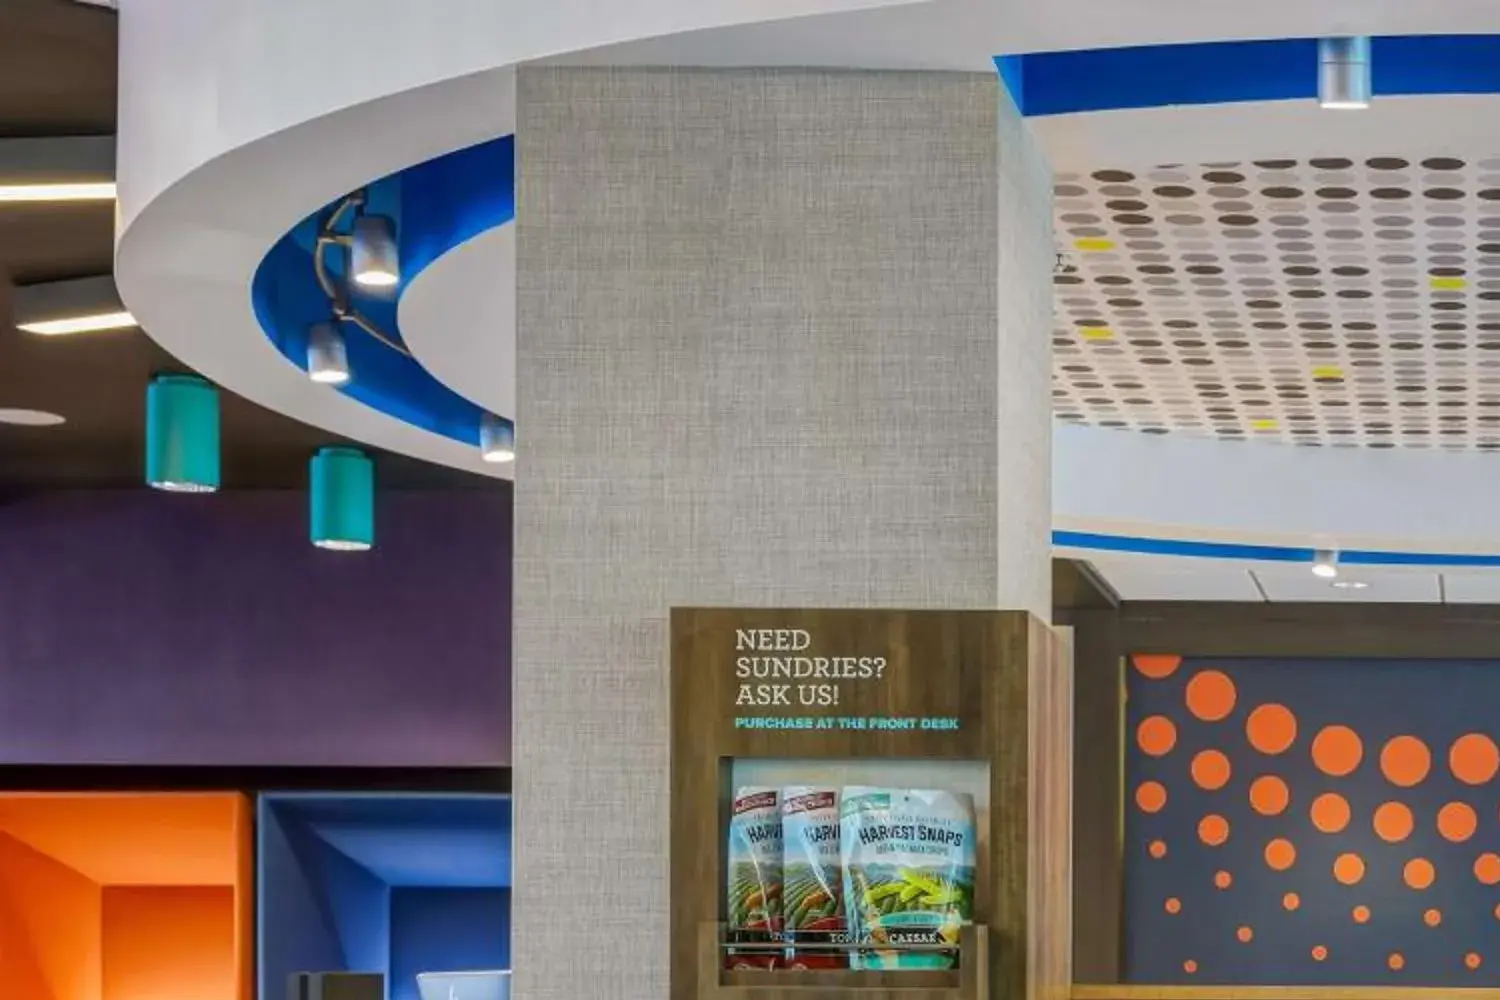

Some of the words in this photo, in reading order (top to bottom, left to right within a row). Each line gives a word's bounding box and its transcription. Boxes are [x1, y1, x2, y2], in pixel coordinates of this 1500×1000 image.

[735, 628, 811, 651] NEED
[735, 656, 887, 679] SUNDRIES?
[735, 684, 791, 706] ASK
[797, 684, 840, 706] US!
[735, 716, 814, 729] PURCHASE
[815, 717, 835, 729] AT
[838, 717, 867, 729] THE
[868, 717, 918, 730] FRONT
[920, 717, 960, 730] DESK
[803, 825, 840, 843] HARV
[858, 825, 917, 845] HARVEST
[918, 825, 964, 847] SNAPS
